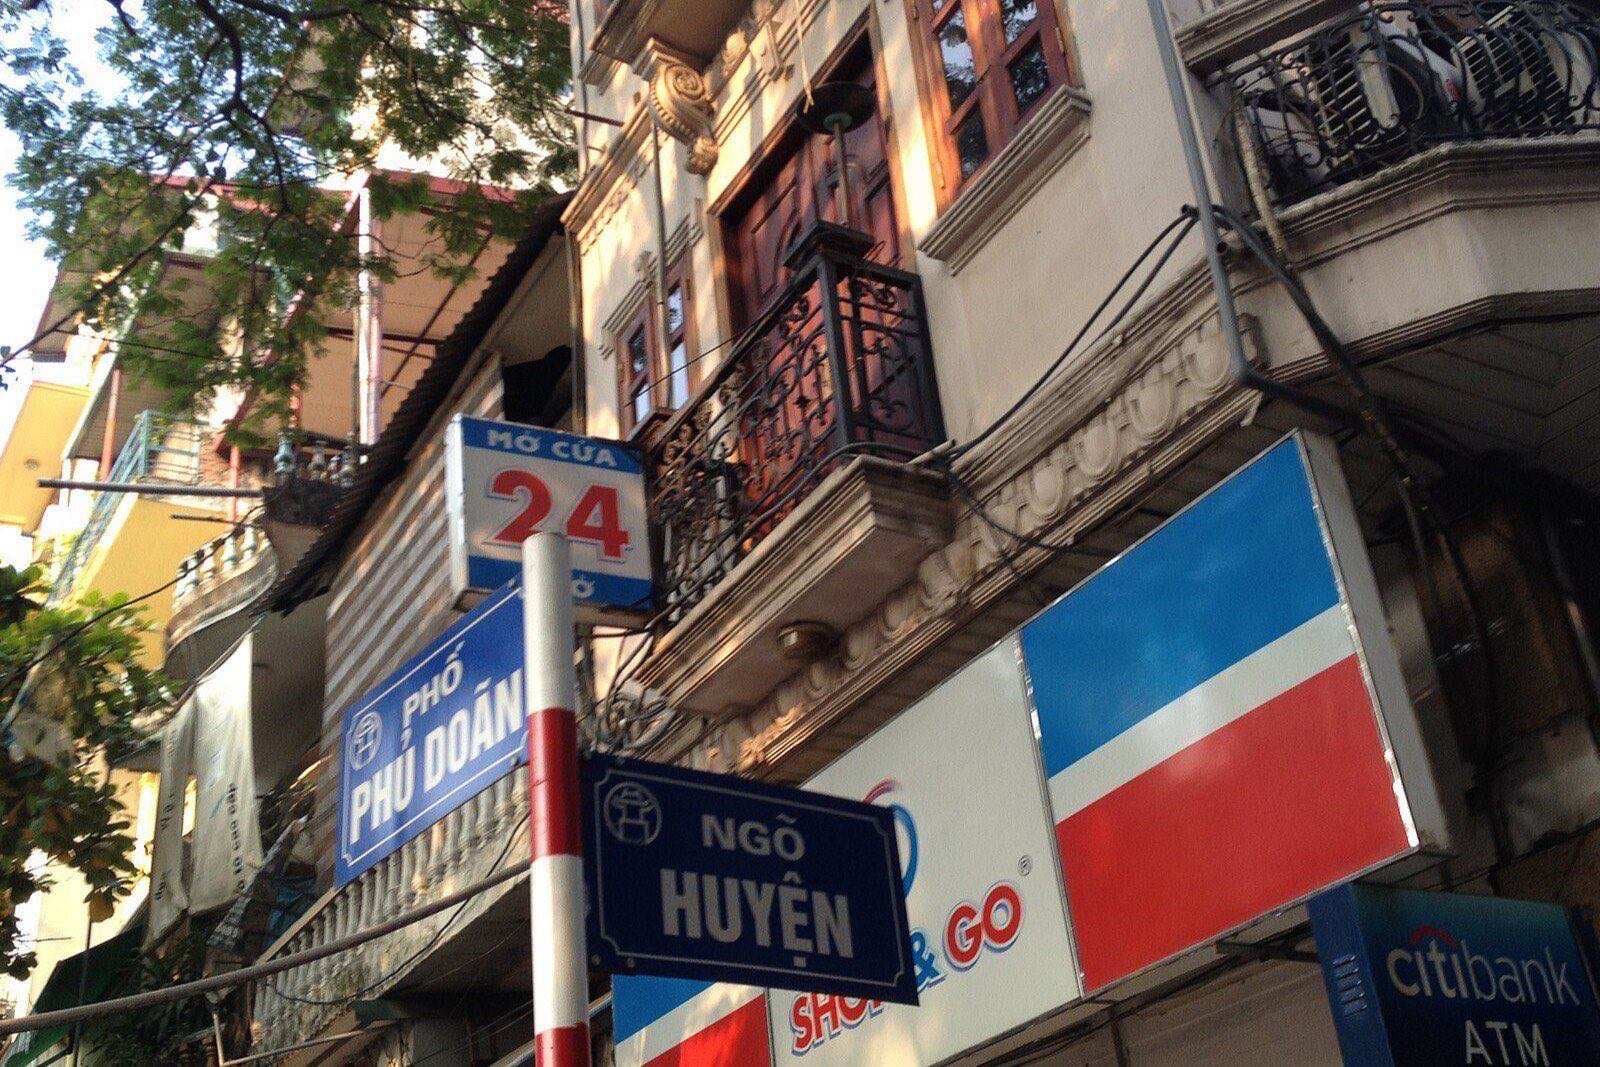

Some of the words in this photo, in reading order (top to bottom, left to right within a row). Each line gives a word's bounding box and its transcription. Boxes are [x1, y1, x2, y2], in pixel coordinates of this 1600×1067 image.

[492, 469, 630, 558] 24
[402, 640, 465, 727] PHỐ
[350, 728, 416, 844] PHỦ
[423, 668, 524, 792] DOÃN
[701, 811, 806, 861] NGÕ
[659, 868, 854, 968] HUYỆN
[945, 884, 1023, 965] GO
[1386, 939, 1581, 1006] citibank
[1464, 1020, 1551, 1067] ATM
